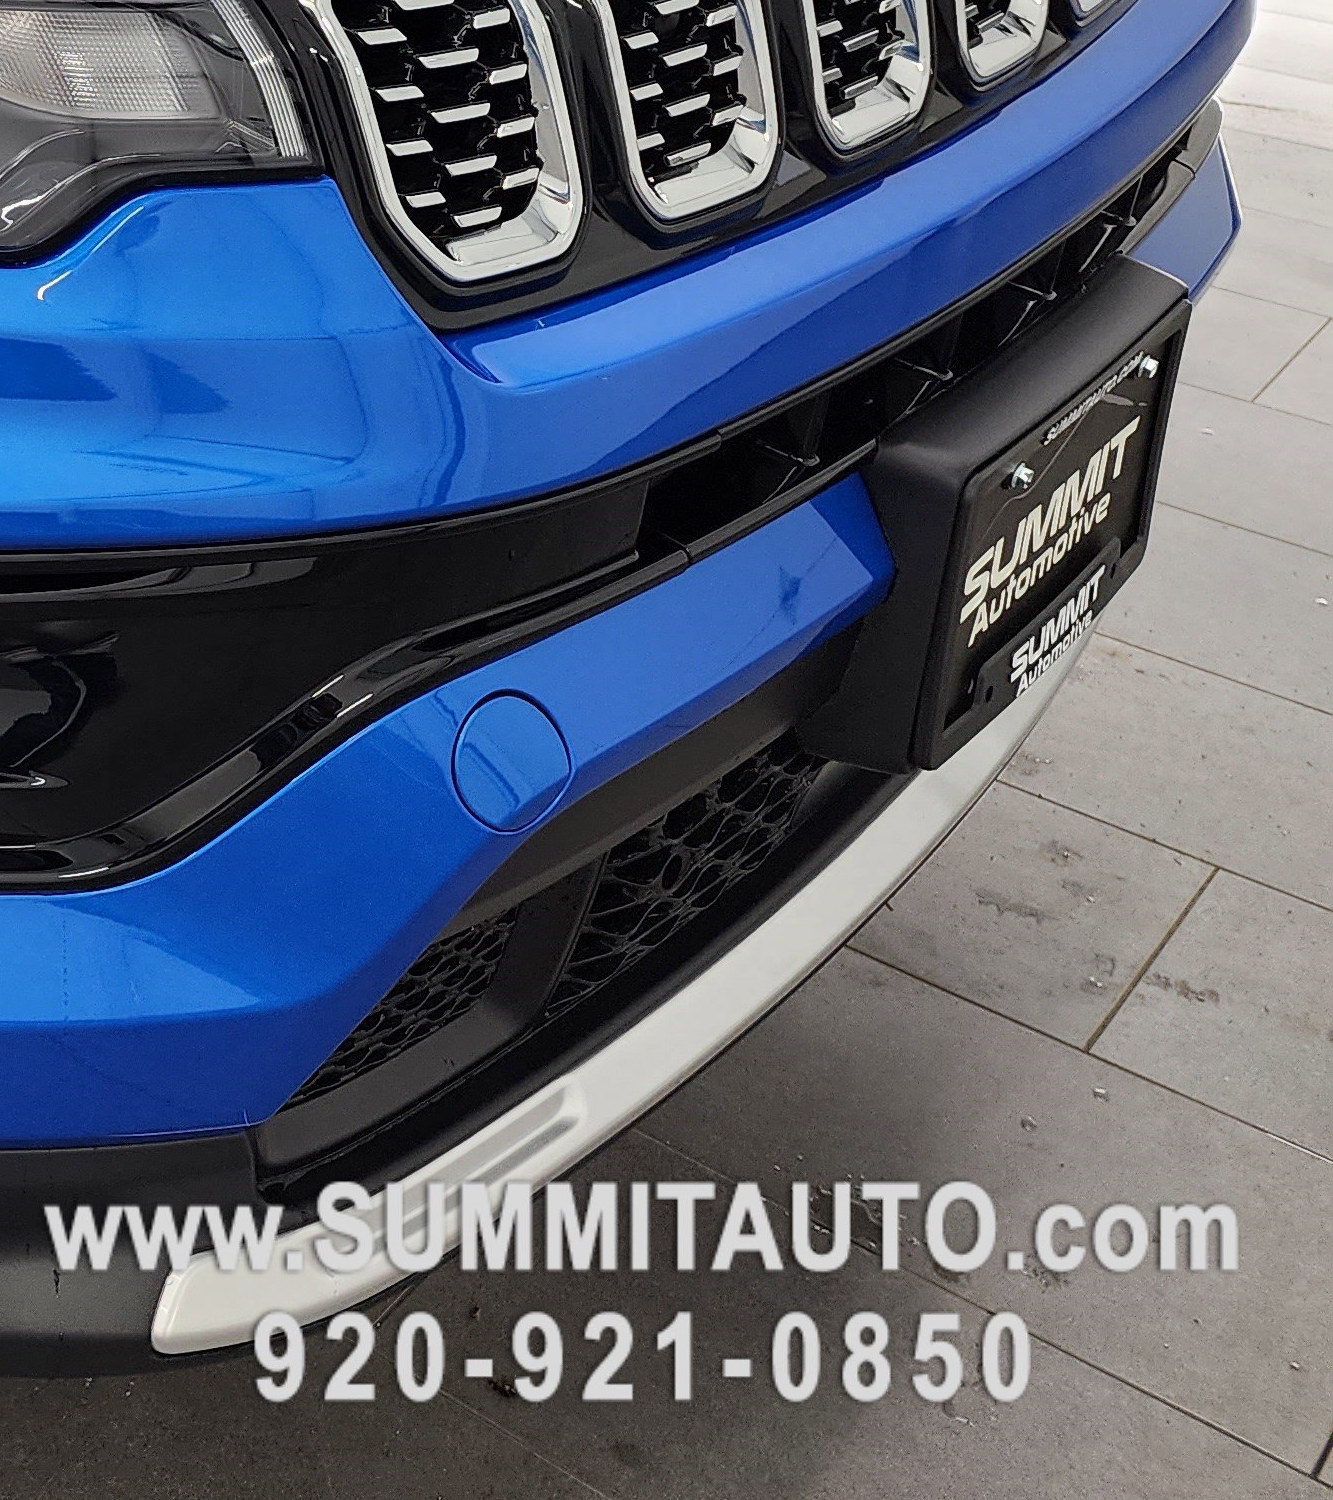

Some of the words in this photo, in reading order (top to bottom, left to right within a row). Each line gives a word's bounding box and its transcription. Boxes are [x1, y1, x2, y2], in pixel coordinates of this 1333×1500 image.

[960, 416, 1141, 624] SUMMIT
[968, 493, 1111, 647] Automotive
[1010, 564, 1106, 684] SUMMIT
[1016, 610, 1093, 697] Automotive
